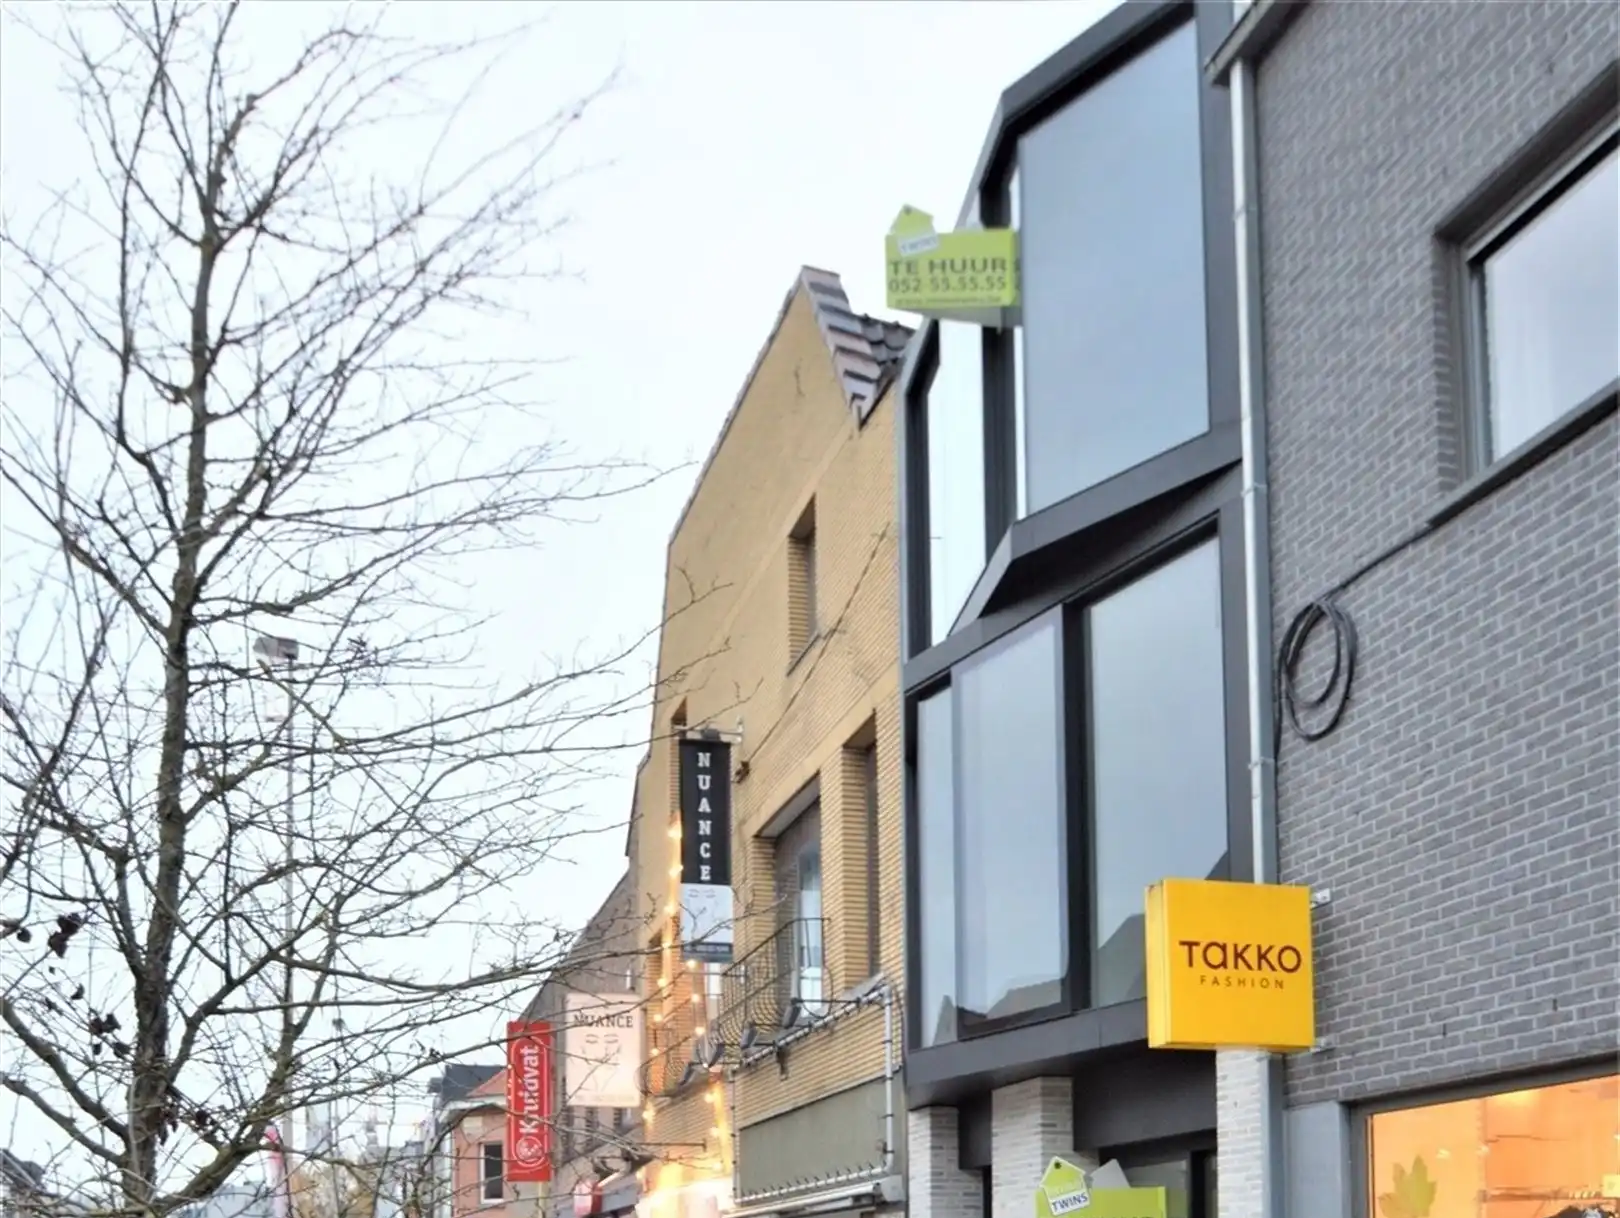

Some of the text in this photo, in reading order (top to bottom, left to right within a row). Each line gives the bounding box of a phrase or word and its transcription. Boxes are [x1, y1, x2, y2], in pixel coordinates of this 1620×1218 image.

[889, 257, 1007, 275] TE HUUR
[697, 752, 712, 881] NUANCE
[1200, 975, 1284, 989] FASHION
[519, 1045, 540, 1134] Kruidvat
[1052, 1192, 1088, 1212] TWINS
